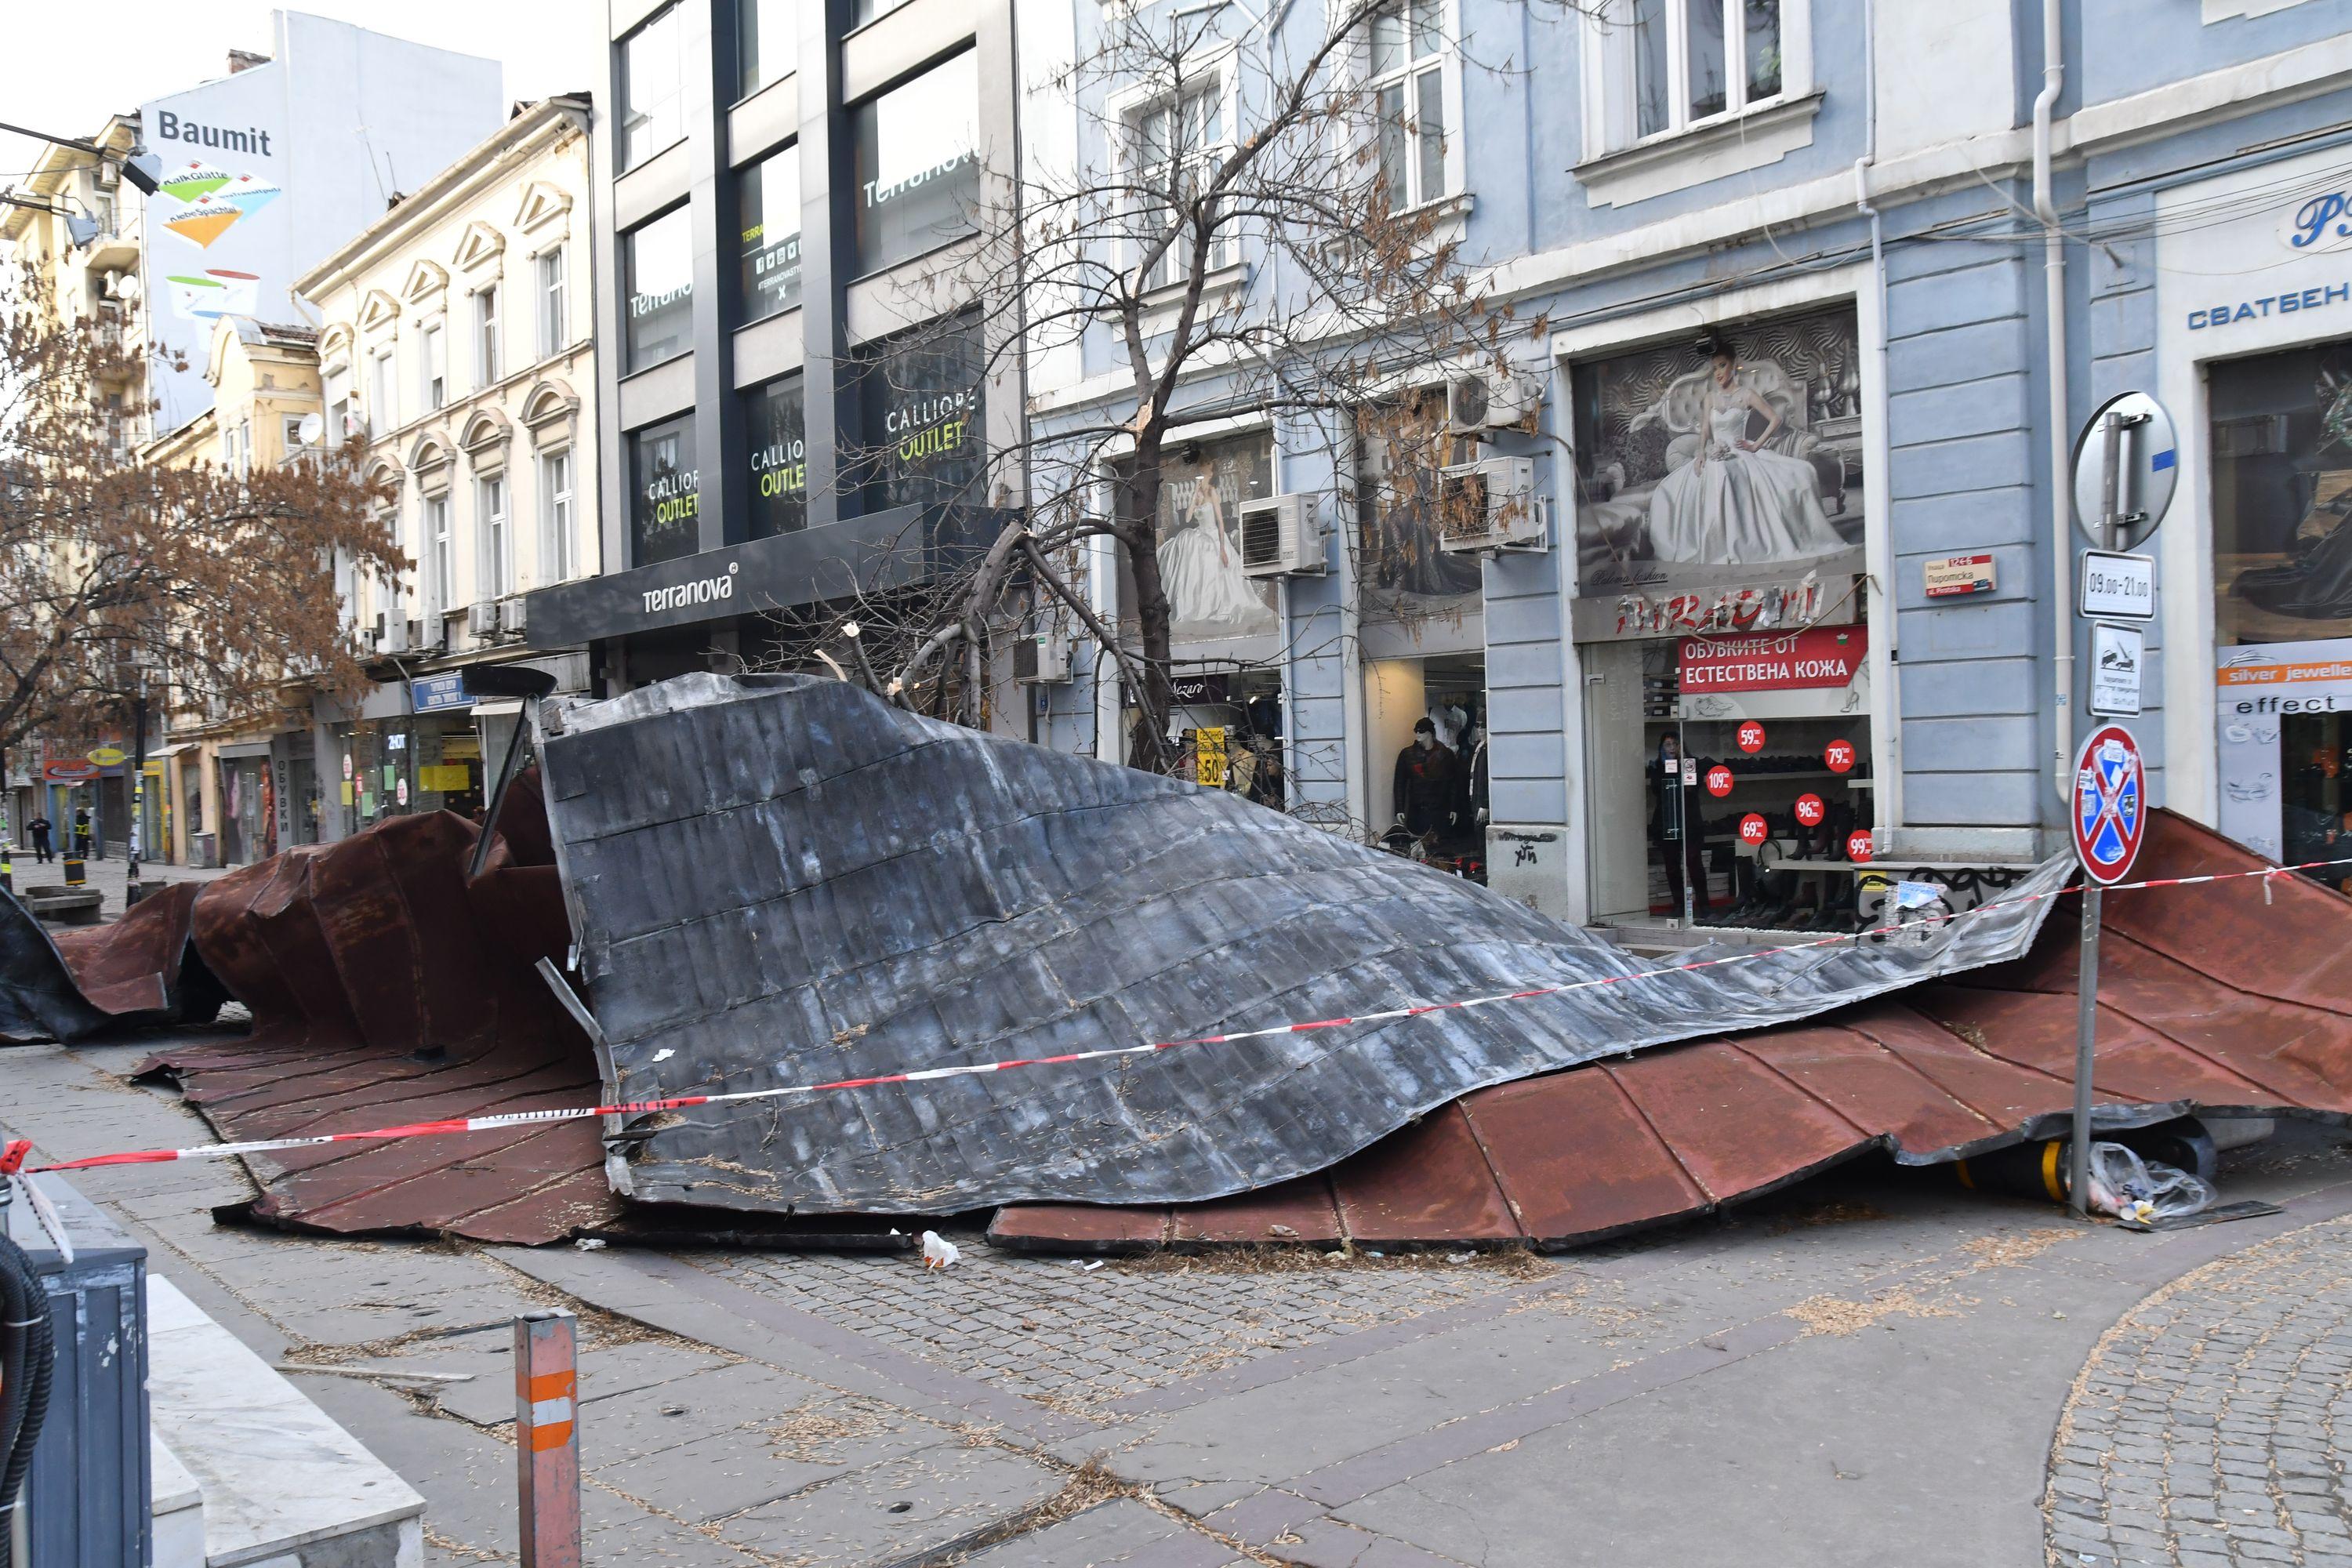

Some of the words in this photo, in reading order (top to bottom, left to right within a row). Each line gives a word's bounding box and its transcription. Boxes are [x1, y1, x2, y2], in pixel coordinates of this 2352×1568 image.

[159, 110, 271, 157] Baumit
[900, 420, 964, 461] OUTLET
[751, 439, 804, 471] CALLIO
[760, 463, 807, 497] OUTLE
[657, 493, 699, 524] OUTLET
[1686, 637, 1771, 659] ОБУВКИТЕ
[1775, 636, 1798, 654] ОТ
[1686, 662, 1790, 684] ЕСТЕСТВЕНА
[1795, 659, 1848, 678] КОЖА
[2229, 669, 2278, 682] silver
[2236, 695, 2336, 713] effect
[1740, 729, 1754, 746] 59
[1828, 747, 1843, 764] 79
[1709, 772, 1724, 789] 109
[278, 760, 289, 832] ОБУВКИ
[1798, 801, 1813, 818] 96
[1743, 822, 1757, 837] 69
[1850, 838, 1866, 855] 99
